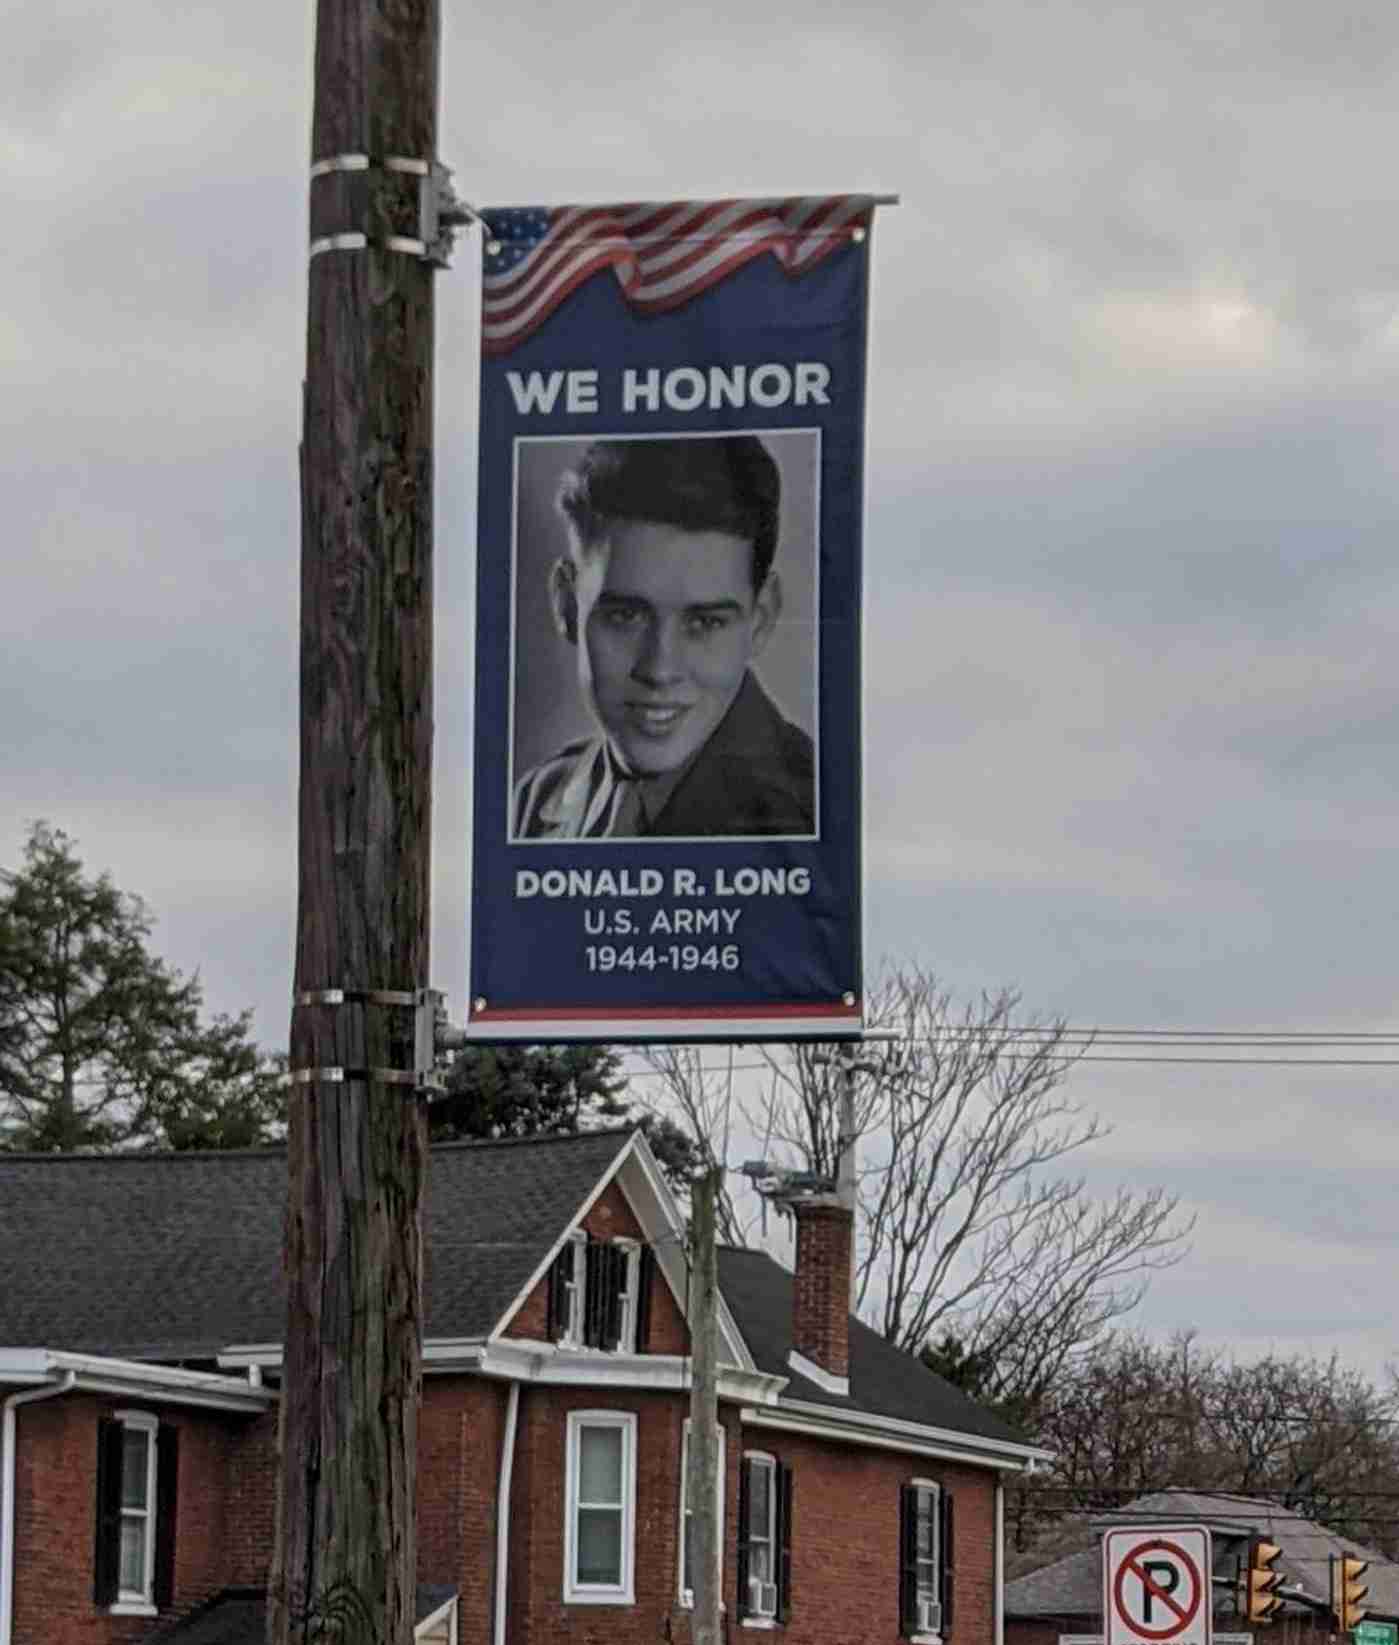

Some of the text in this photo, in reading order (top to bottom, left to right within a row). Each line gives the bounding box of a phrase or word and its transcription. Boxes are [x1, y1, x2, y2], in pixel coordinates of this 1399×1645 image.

[506, 362, 832, 414] WE HONOR
[515, 868, 811, 897] DONALD R. LONG
[583, 909, 741, 934] U.S. ARMY
[585, 946, 740, 971] 1944-1946
